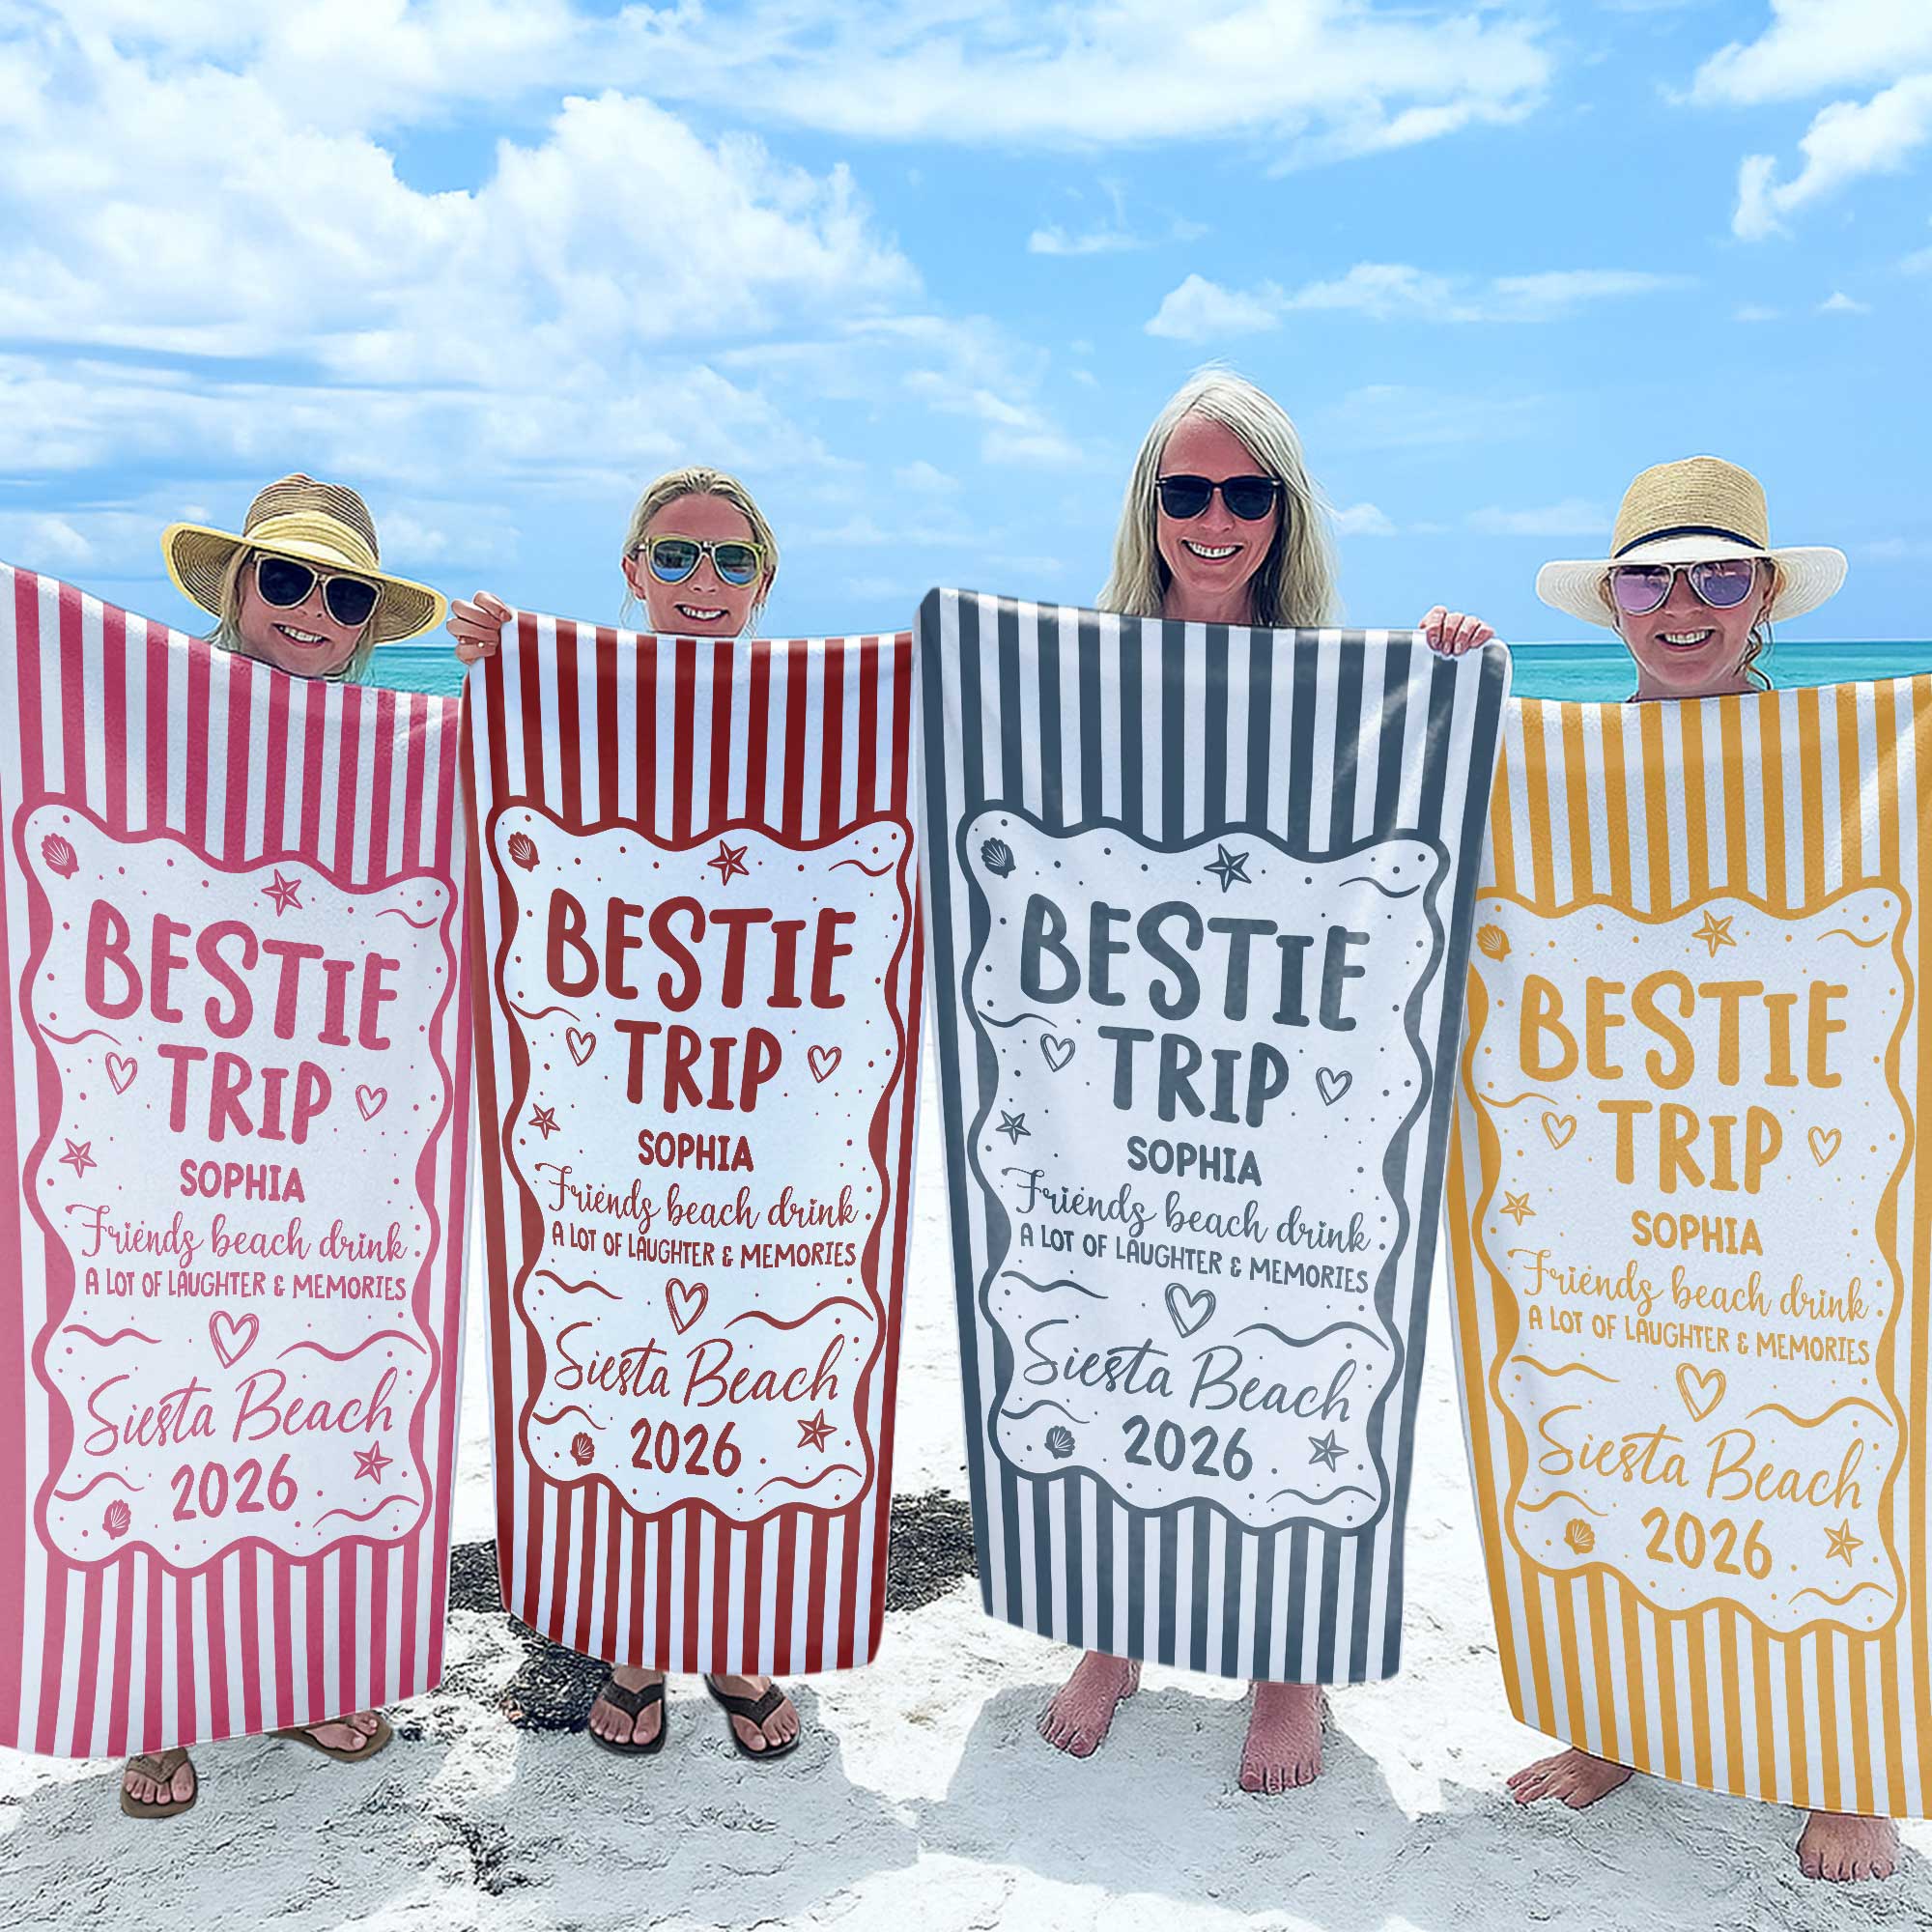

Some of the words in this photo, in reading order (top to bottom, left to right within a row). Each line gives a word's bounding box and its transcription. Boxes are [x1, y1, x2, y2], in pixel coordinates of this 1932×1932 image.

[85, 898, 400, 1050] BESTIE
[547, 888, 856, 1012] BESTIE
[1020, 894, 1370, 1032] BESTIE
[1520, 969, 1848, 1090] BESTIE
[157, 1044, 331, 1145] TRIP
[614, 1019, 781, 1113] TRIP
[1097, 1026, 1289, 1127] TRIP
[181, 1159, 305, 1203] SOPHIA
[639, 1129, 753, 1172] SOPHIA
[1127, 1136, 1262, 1186] SOPHIA
[1598, 1100, 1782, 1194] TRIP
[534, 1163, 661, 1235] Friends
[668, 1183, 760, 1229] beach
[768, 1185, 859, 1228] drink
[1002, 1167, 1157, 1237] Friends
[1166, 1191, 1268, 1243] beach
[1277, 1206, 1371, 1253] drink
[1632, 1210, 1763, 1256] SOPHIA
[66, 1205, 204, 1268] Friends
[212, 1213, 311, 1260] beach
[320, 1219, 408, 1263] drink
[553, 1221, 564, 1246] A
[570, 1223, 596, 1251] LOT
[604, 1233, 622, 1257] OF
[629, 1234, 715, 1266] LAUGHTER
[723, 1246, 733, 1267] &
[741, 1241, 856, 1268] MEMORIES
[1021, 1223, 1034, 1246] A
[1041, 1225, 1074, 1252] LOT
[1083, 1235, 1107, 1258] OF
[1117, 1236, 1222, 1274] LAUGHTER
[1231, 1257, 1241, 1277] &
[1250, 1257, 1368, 1293] MEMORIES
[86, 1267, 99, 1294] A
[106, 1268, 134, 1296] LOT
[142, 1271, 162, 1297] OF
[169, 1270, 266, 1297] LAUGHTER
[273, 1275, 285, 1296] &
[293, 1274, 406, 1300] MEMORIES
[1507, 1249, 1663, 1317] Friends
[1672, 1265, 1772, 1317] beach
[1780, 1273, 1869, 1322] drink
[554, 1321, 670, 1397] Siesta
[684, 1334, 844, 1406] Beach
[1023, 1320, 1173, 1397] Siesta
[1190, 1346, 1356, 1422] Beach
[1529, 1305, 1543, 1329] A
[1549, 1306, 1582, 1334] LOT
[1592, 1315, 1616, 1339] OF
[1625, 1315, 1729, 1352] LAUGHTER
[1738, 1332, 1748, 1354] &
[1756, 1332, 1869, 1365] MEMORIES
[84, 1375, 215, 1456] Siesta
[233, 1367, 396, 1442] Beach
[631, 1418, 741, 1477] 2026
[1122, 1415, 1253, 1481] 2026
[1538, 1405, 1690, 1487] Siesta
[1707, 1429, 1863, 1510] Beach
[171, 1454, 298, 1521] 2026
[1641, 1507, 1773, 1579] 2026
